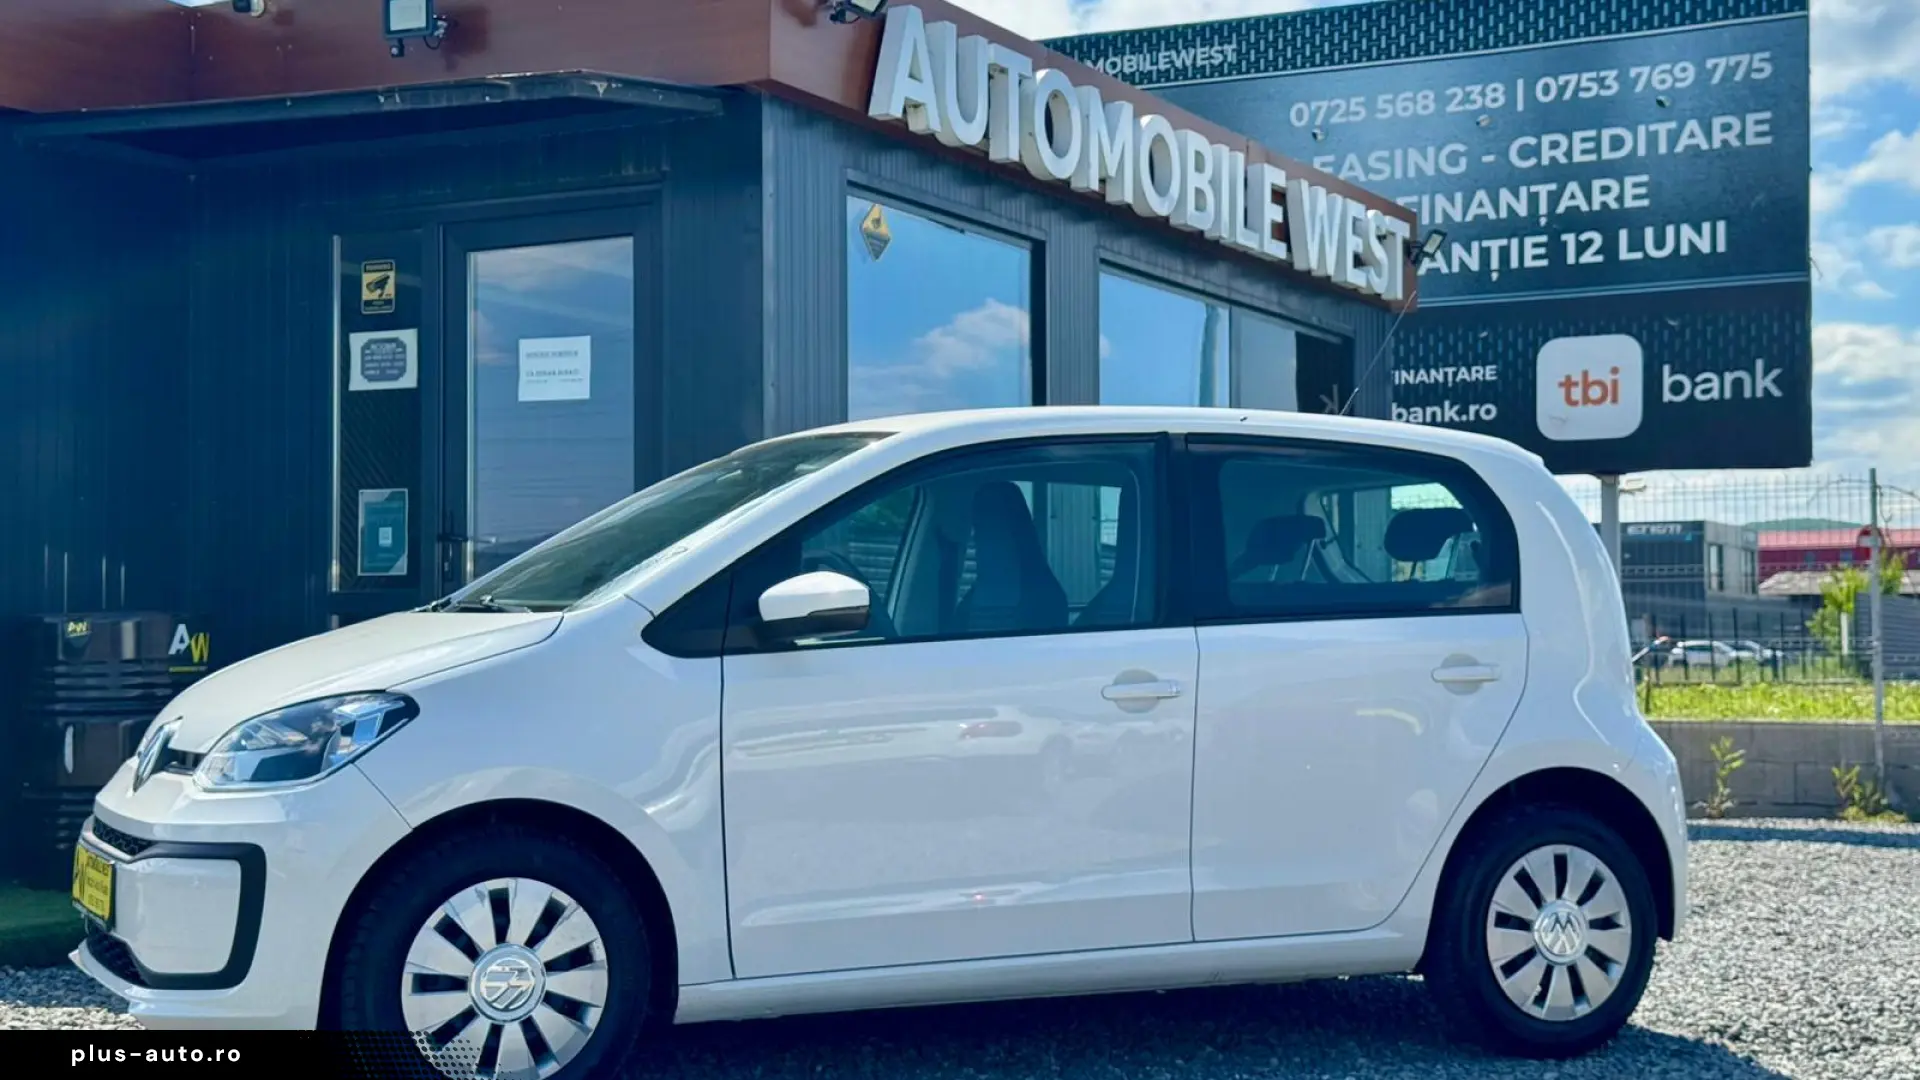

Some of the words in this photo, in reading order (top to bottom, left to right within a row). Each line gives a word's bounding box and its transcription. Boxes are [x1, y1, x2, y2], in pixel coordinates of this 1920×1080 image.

[1289, 97, 1367, 128] 0725
[1374, 90, 1437, 120] 568
[1445, 82, 1506, 113] 238
[1535, 69, 1620, 103] 0753
[1629, 61, 1696, 93] 769
[1705, 51, 1773, 85] 775
[868, 5, 1287, 262] AUTOMOBILE
[1287, 178, 1412, 301] WEST
[1312, 143, 1469, 183] EASING
[1508, 111, 1774, 169] CREDITARE
[1560, 231, 1605, 265] 12
[1618, 220, 1726, 261] LUNI
[1392, 364, 1498, 388] INANȚARE
[1558, 366, 1621, 407] tbi
[1662, 358, 1783, 403] bank
[1392, 400, 1498, 423] bank.ro
